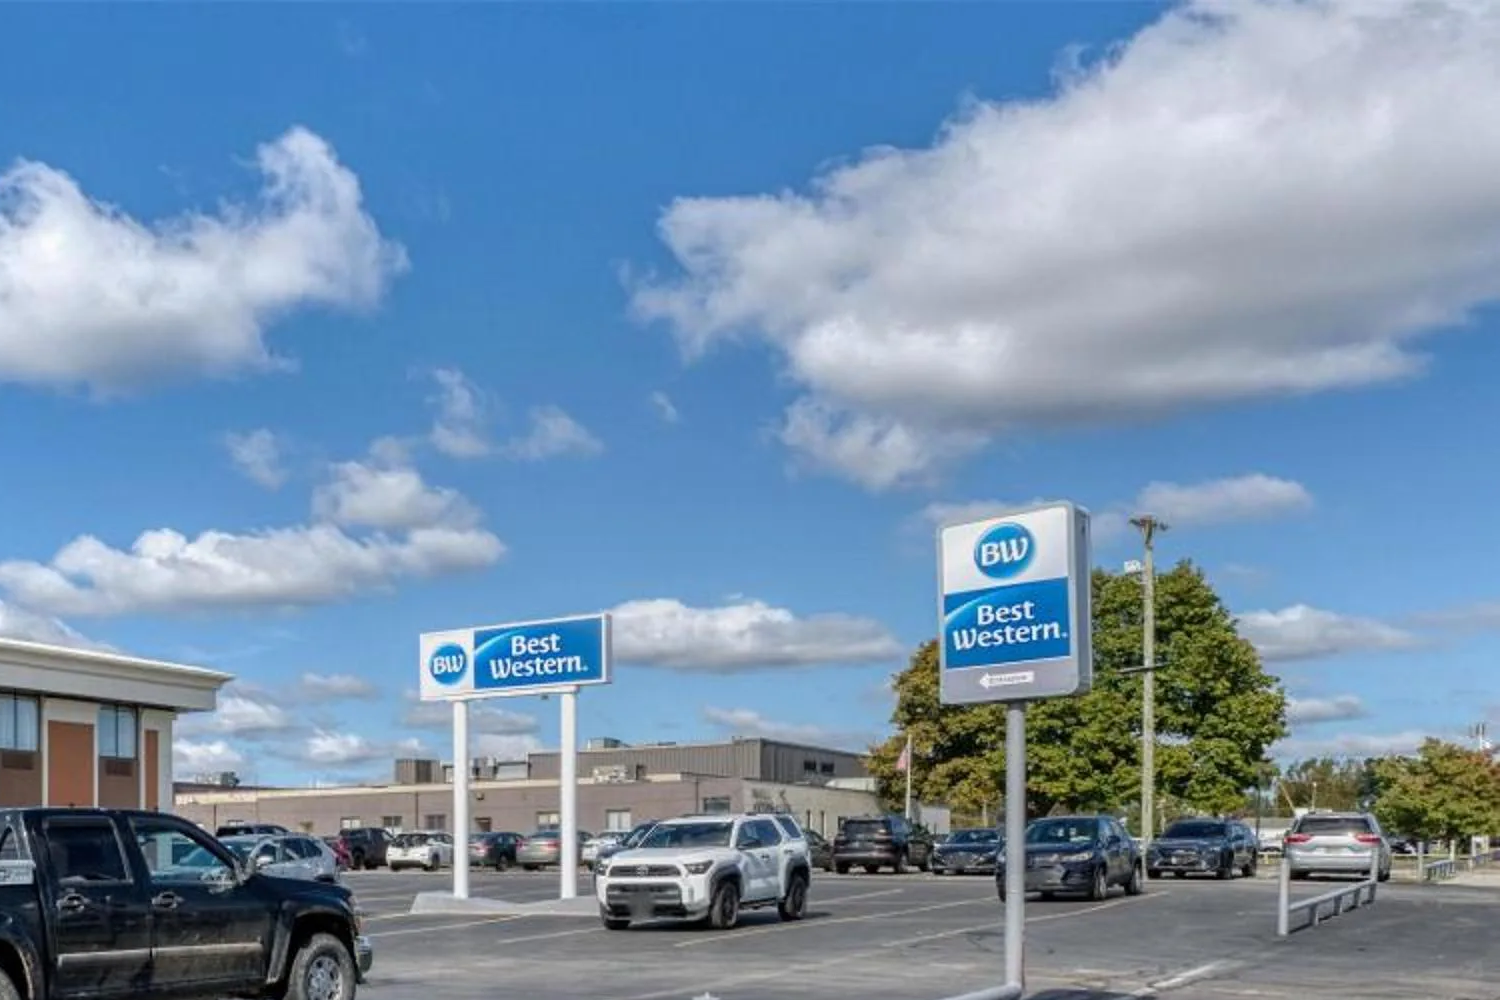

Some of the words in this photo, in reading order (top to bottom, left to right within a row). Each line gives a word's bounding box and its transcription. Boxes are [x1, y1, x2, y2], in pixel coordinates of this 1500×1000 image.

[981, 537, 1029, 567] BW
[977, 600, 1035, 626] Best
[511, 633, 561, 657] Best
[433, 655, 464, 675] BW
